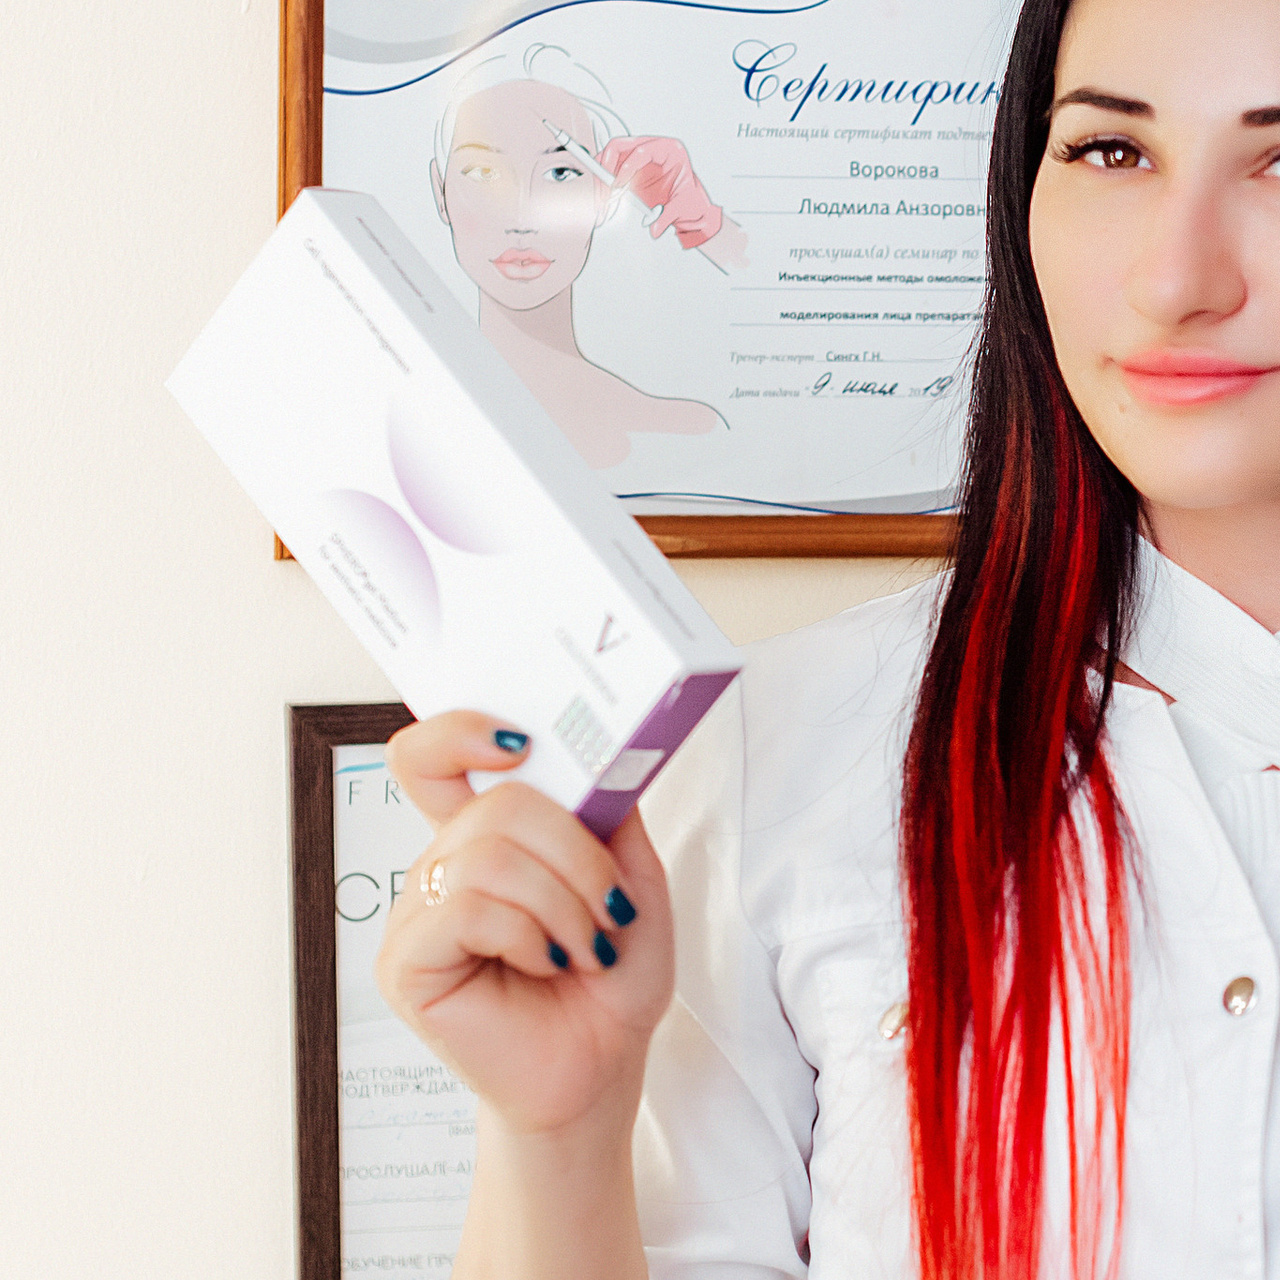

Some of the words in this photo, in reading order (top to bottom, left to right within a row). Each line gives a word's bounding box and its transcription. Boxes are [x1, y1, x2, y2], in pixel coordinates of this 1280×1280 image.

[736, 122, 830, 141] Настоящий
[833, 126, 933, 145] сертификат
[849, 160, 941, 182] Ворокова
[798, 198, 891, 220] Людмила
[788, 246, 889, 264] прослушал(а)
[892, 248, 957, 265] семинар
[777, 271, 876, 285] Инъекционные
[875, 273, 926, 286] методы
[779, 310, 880, 324] моделирования
[881, 311, 913, 323] лица
